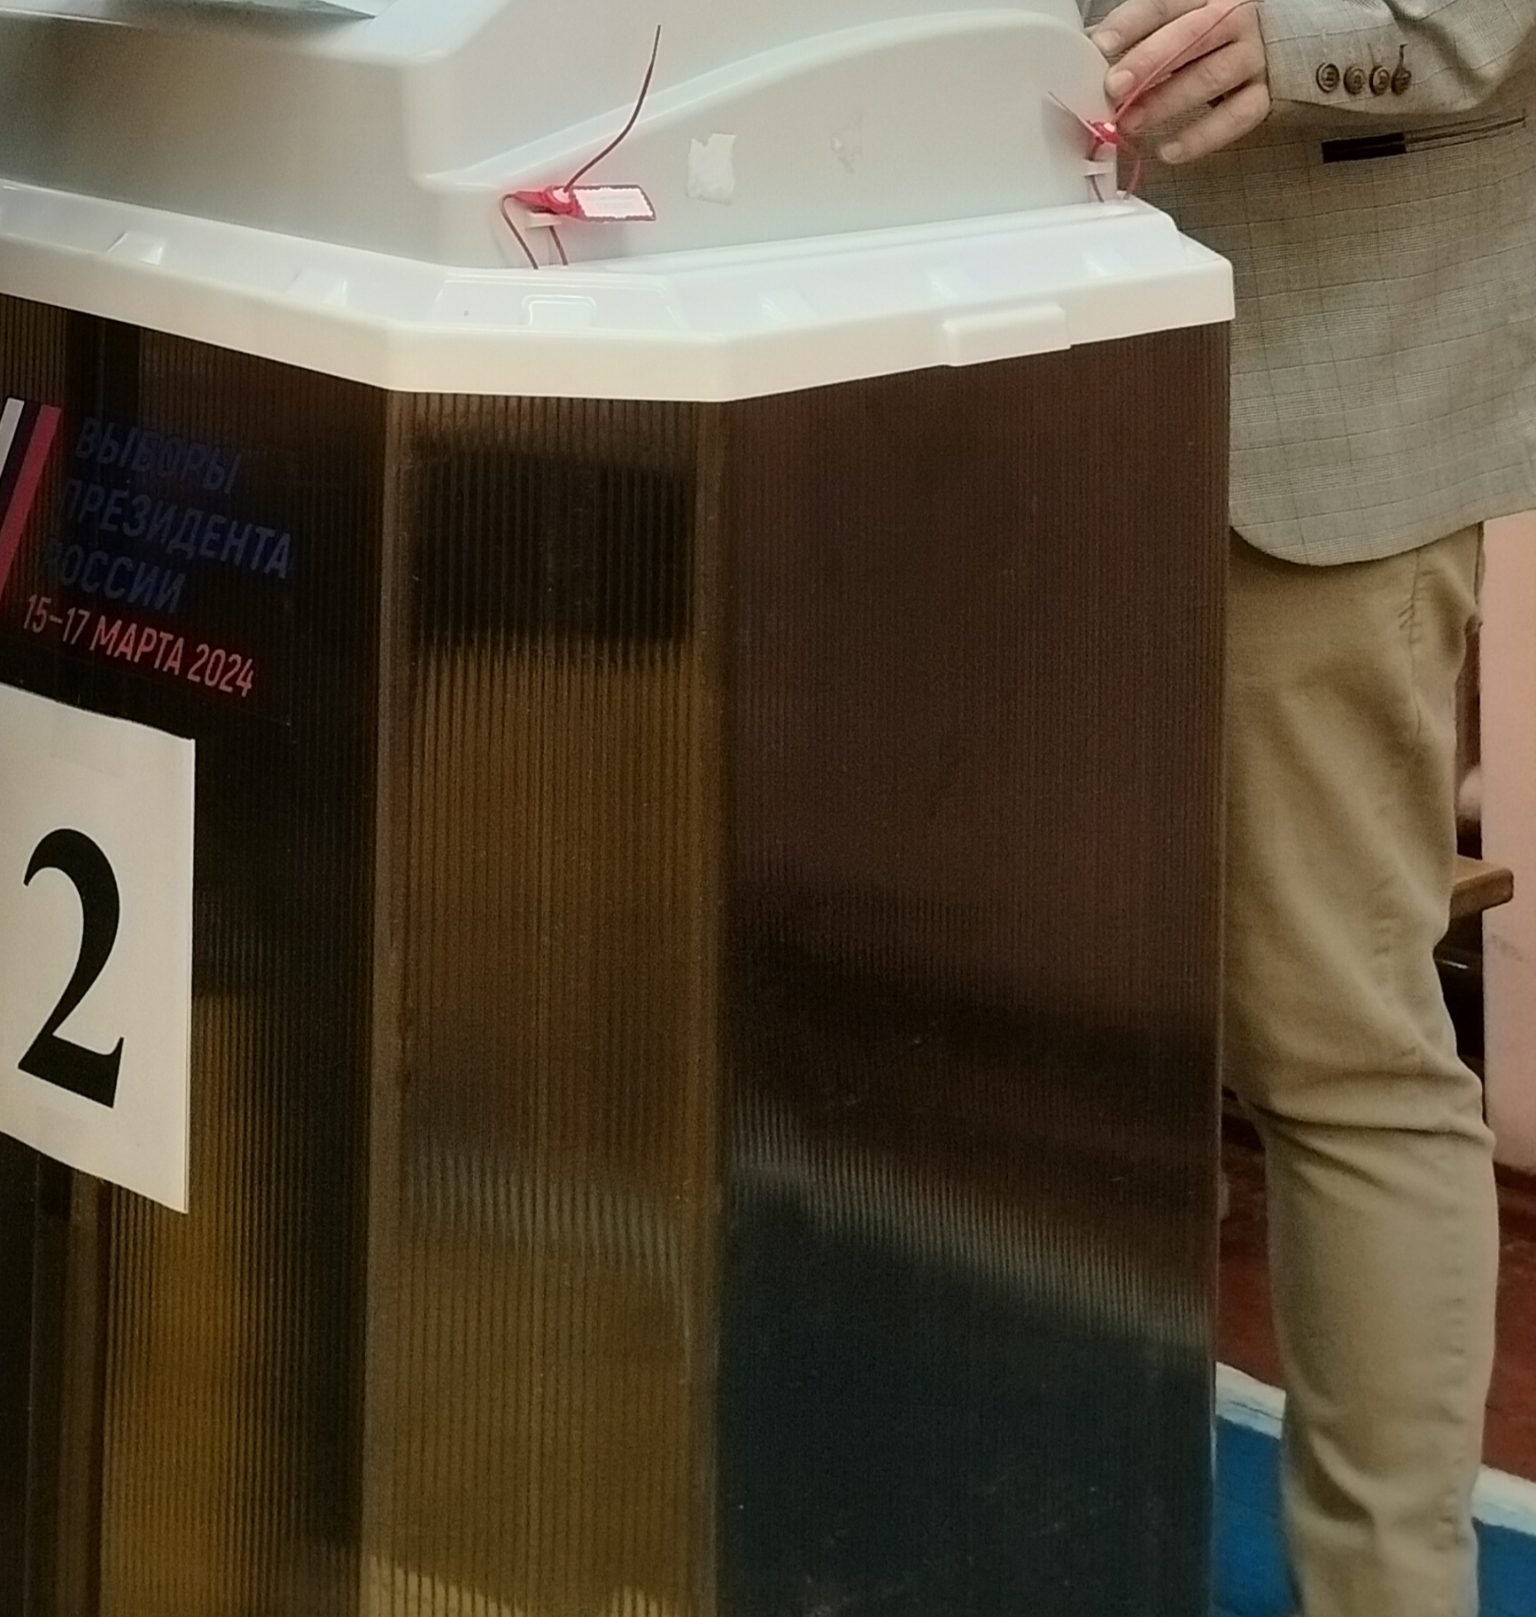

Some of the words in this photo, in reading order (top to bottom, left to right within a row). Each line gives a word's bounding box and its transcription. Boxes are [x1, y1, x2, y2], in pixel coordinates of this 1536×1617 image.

[74, 416, 242, 495] ВЫБОРЫ
[59, 477, 293, 580] ПРЕЗИДЕНТА
[44, 536, 187, 614] РОССИИ
[88, 613, 186, 676] МАРТА
[187, 641, 256, 698] 2024
[17, 827, 125, 1110] 2
